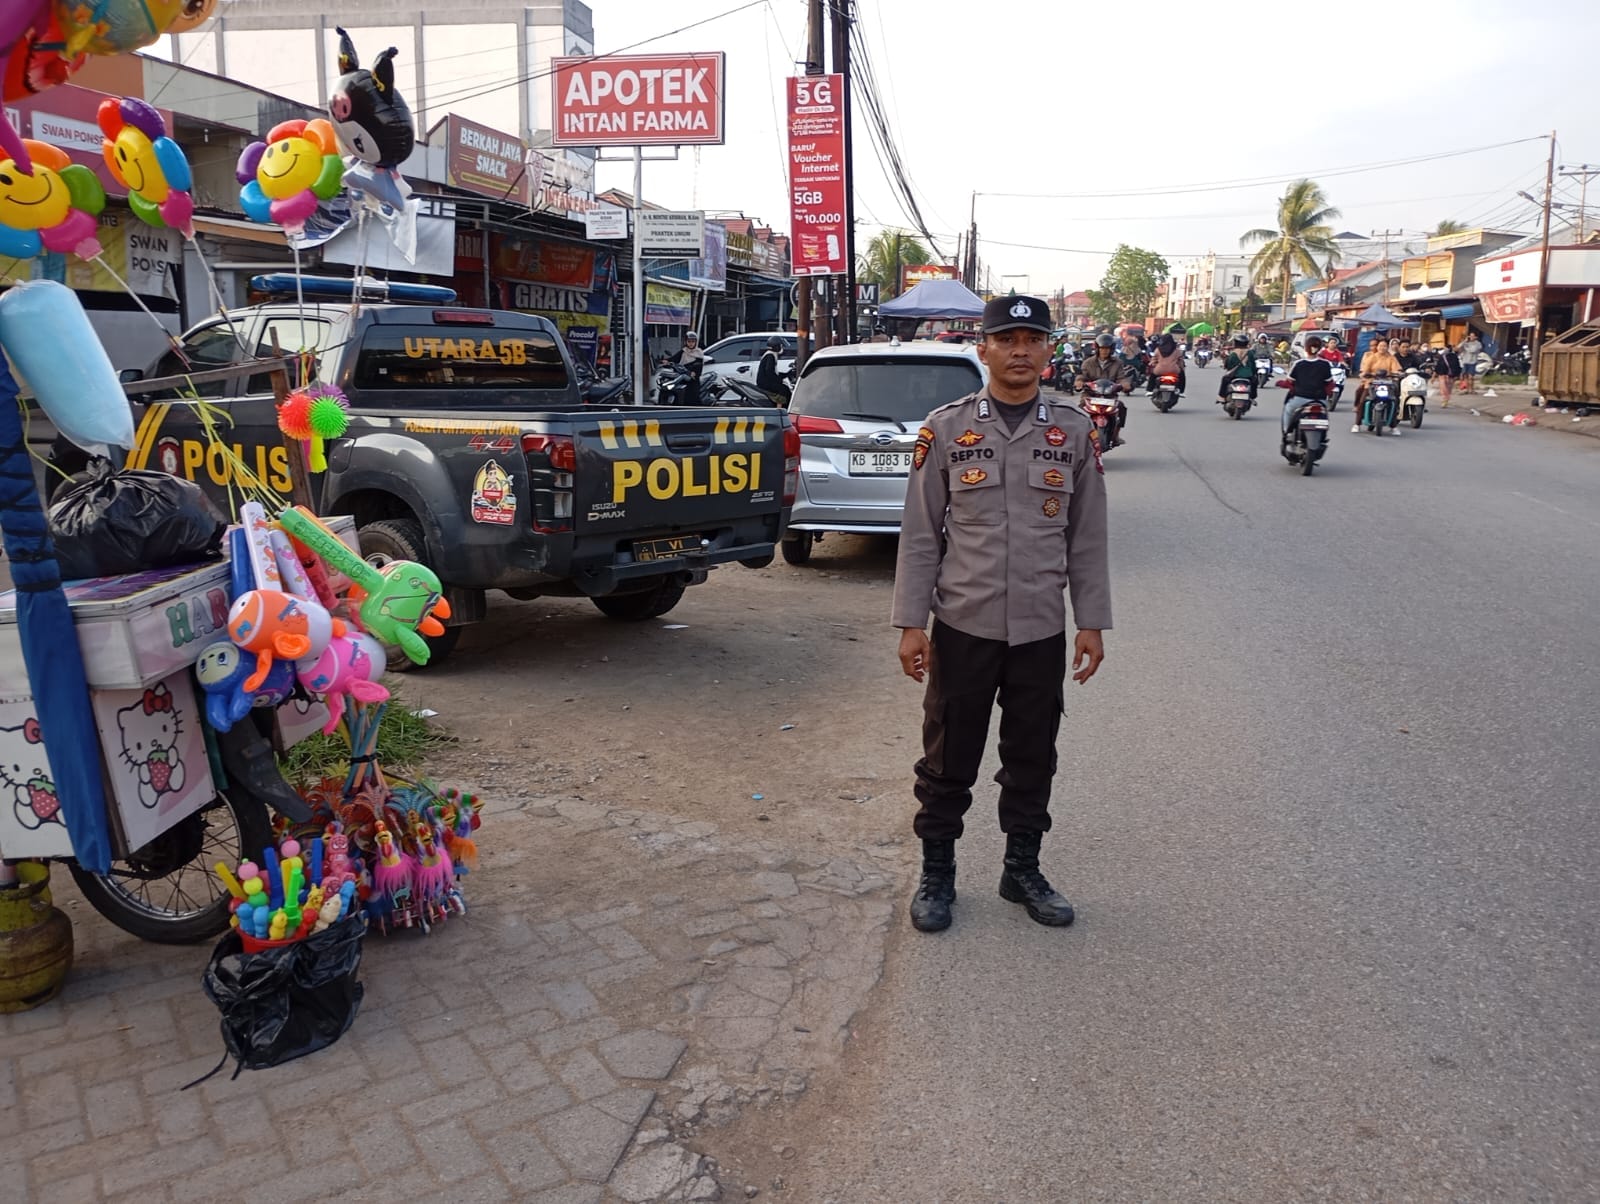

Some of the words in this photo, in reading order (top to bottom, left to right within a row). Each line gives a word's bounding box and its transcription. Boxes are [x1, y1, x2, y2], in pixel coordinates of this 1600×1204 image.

[564, 68, 709, 107] APOTEK
[796, 81, 832, 105] 5G
[564, 111, 627, 133] INTAN
[633, 110, 709, 132] FARMA
[41, 122, 73, 141] SWAN
[74, 129, 105, 147] PONSE
[459, 127, 499, 154] BERKAH
[500, 141, 523, 164] JAYA
[475, 155, 508, 179] SNACK
[793, 152, 832, 163] Voucher
[801, 162, 839, 173] Internet
[794, 191, 823, 205] 5GB
[804, 213, 841, 224] 10.000
[130, 234, 169, 253] SWAN
[514, 283, 589, 313] GRATIS
[404, 336, 496, 360] UTARA
[499, 338, 527, 365] 5B
[183, 439, 294, 493] POLIS
[852, 454, 866, 466] KB
[871, 454, 899, 466] 1083
[951, 448, 994, 463] SEPTO
[1033, 449, 1073, 464] POLRI
[613, 453, 761, 504] POLISI
[591, 502, 617, 511] ISUZU
